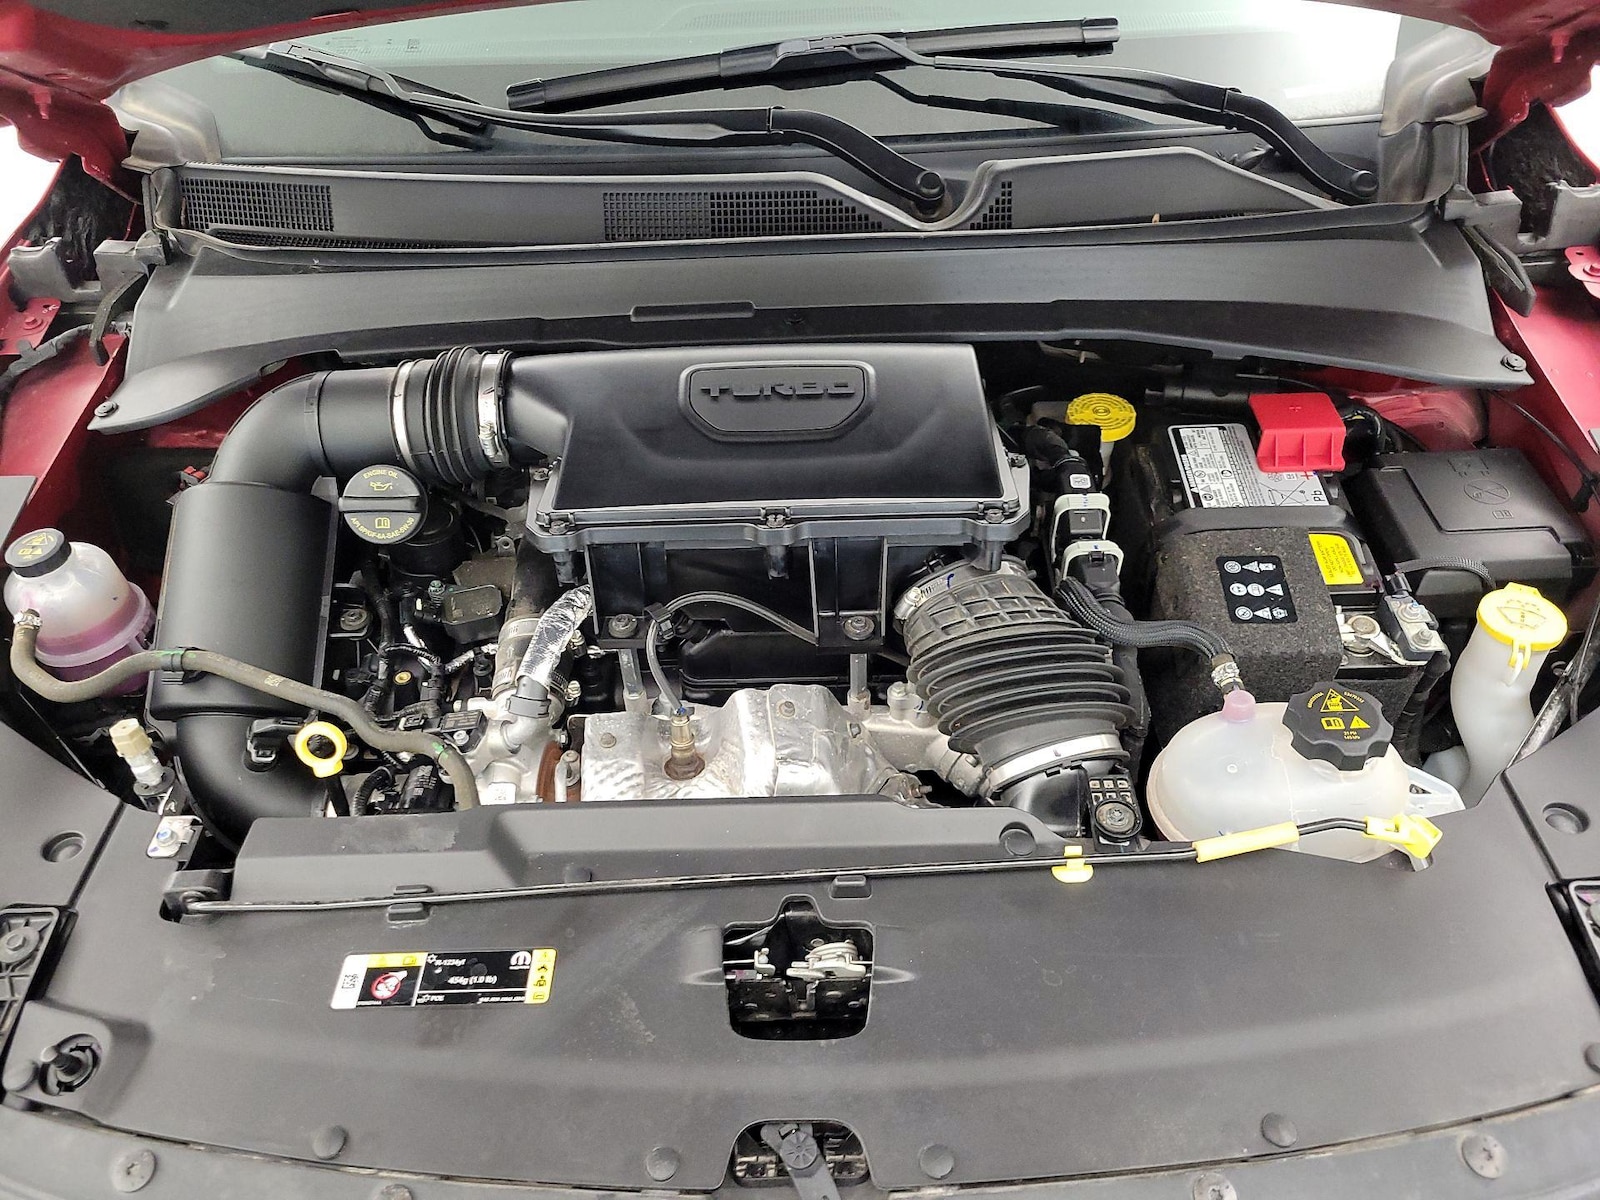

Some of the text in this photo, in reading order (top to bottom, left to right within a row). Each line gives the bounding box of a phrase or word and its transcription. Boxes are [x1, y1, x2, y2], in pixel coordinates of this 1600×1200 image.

[701, 382, 856, 397] TURBO
[362, 469, 399, 479] ENGINE OIL
[1313, 490, 1326, 502] Pb
[447, 976, 469, 985] 454g
[469, 975, 485, 985] (1.0
